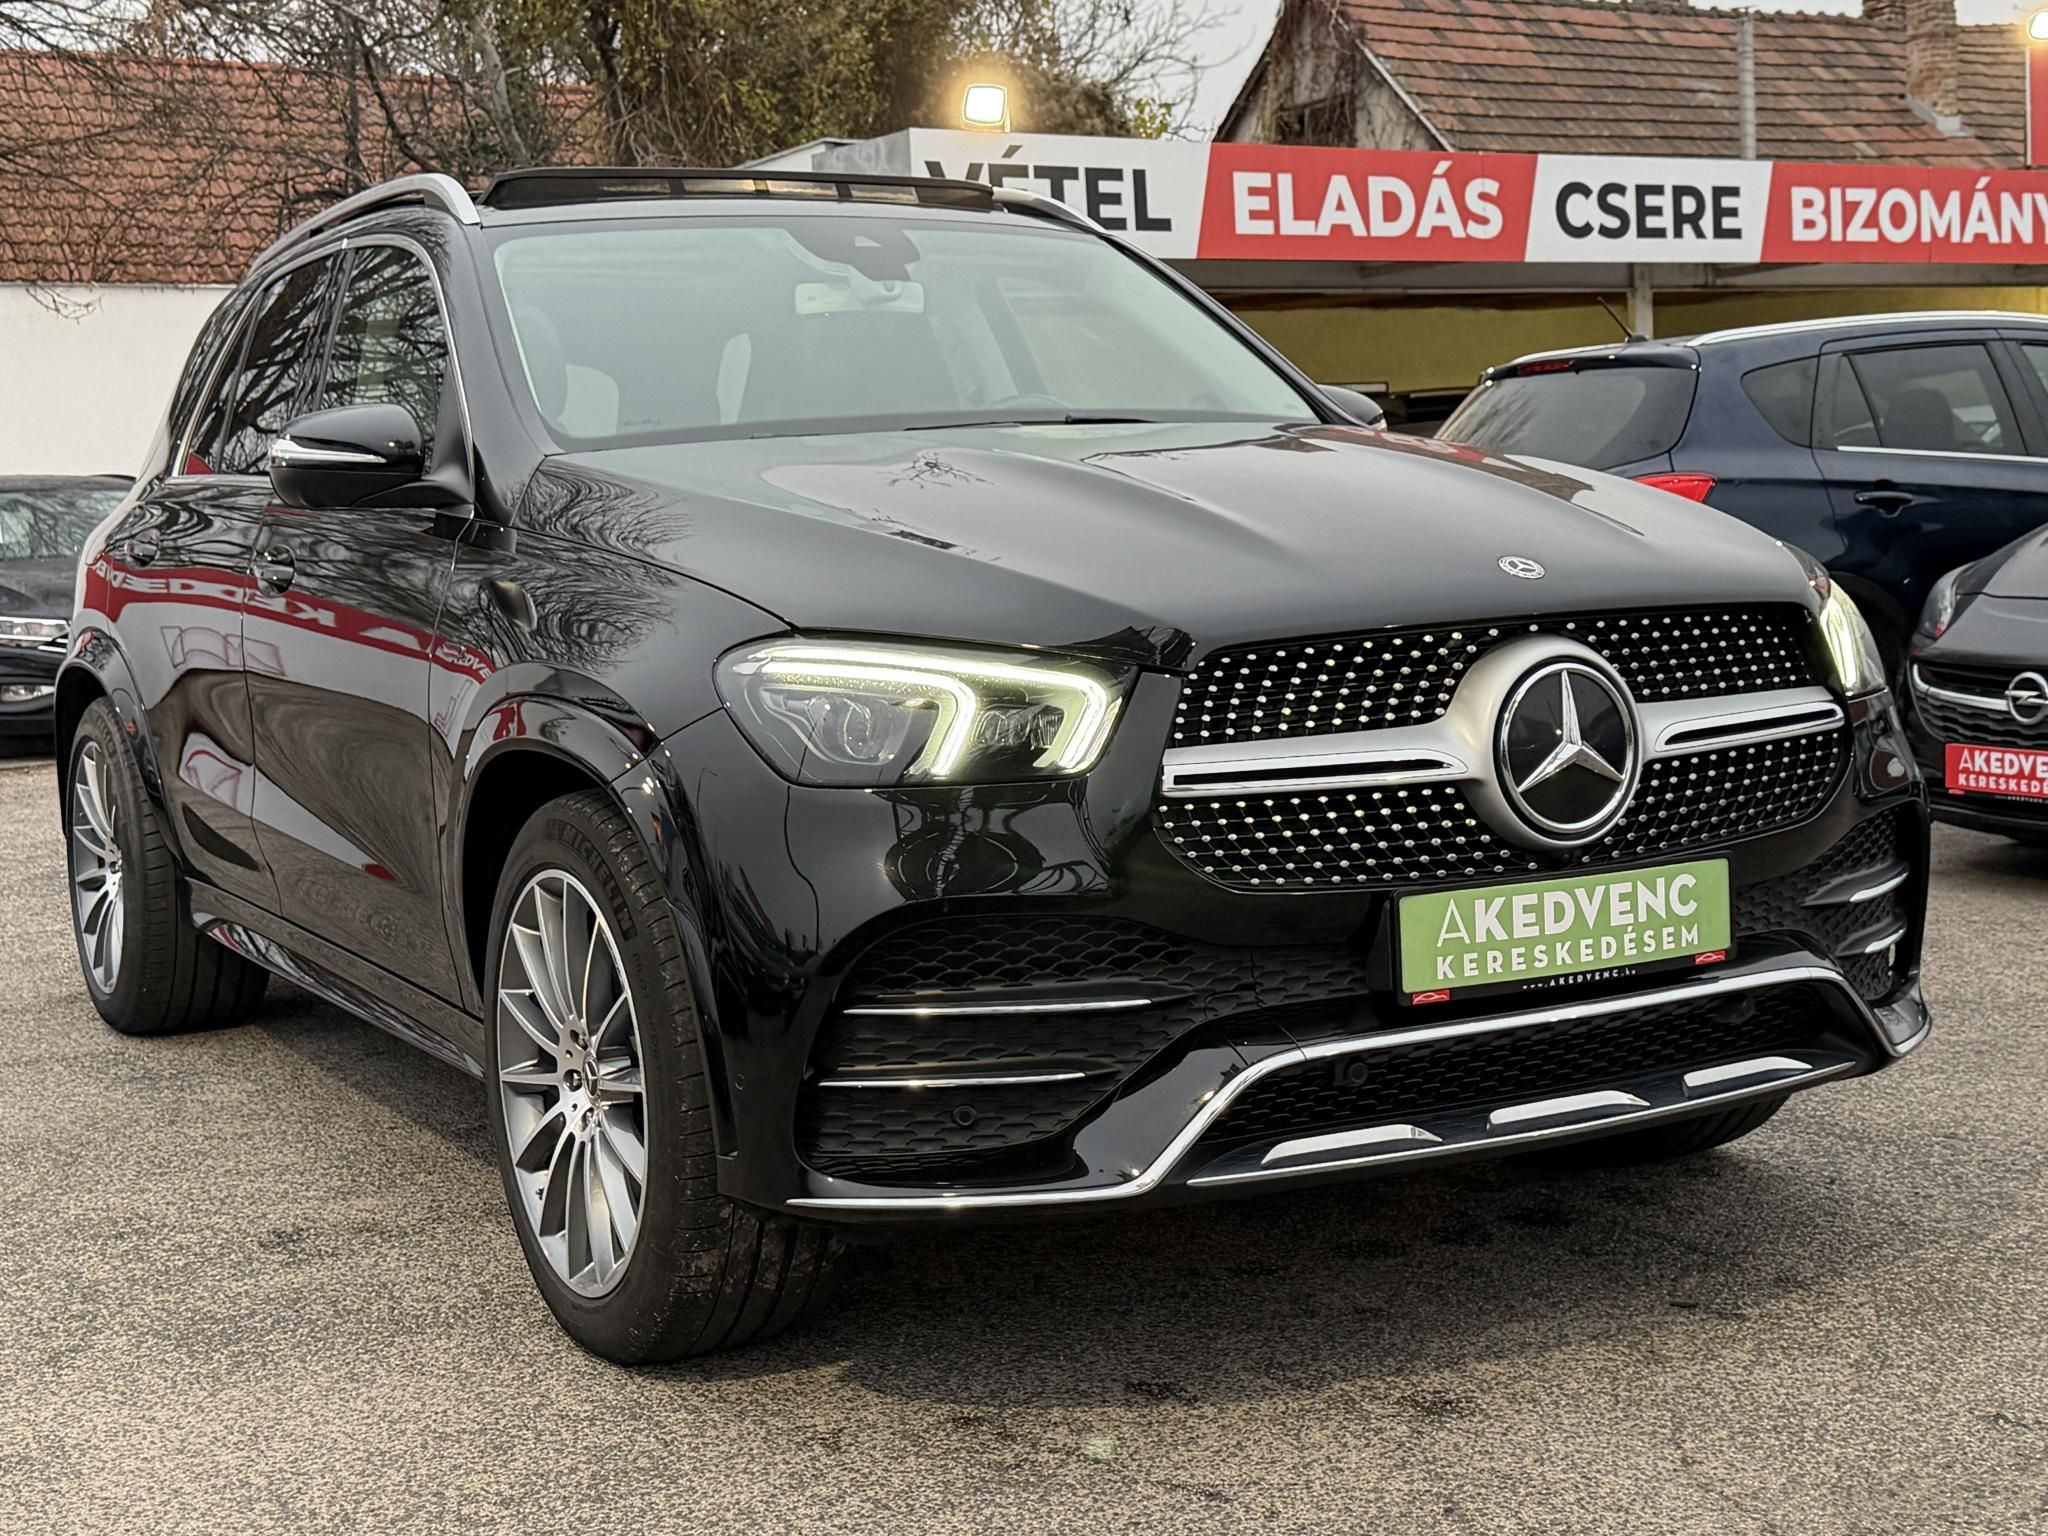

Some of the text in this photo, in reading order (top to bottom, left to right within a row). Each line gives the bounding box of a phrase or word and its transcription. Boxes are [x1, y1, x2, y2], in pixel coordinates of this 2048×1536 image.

[1232, 160, 1503, 240] ELADÁS
[1555, 182, 1743, 240] CSERE
[1436, 873, 1698, 948] AKEDVENC
[1436, 923, 1700, 980] KERESKEDÉSEM
